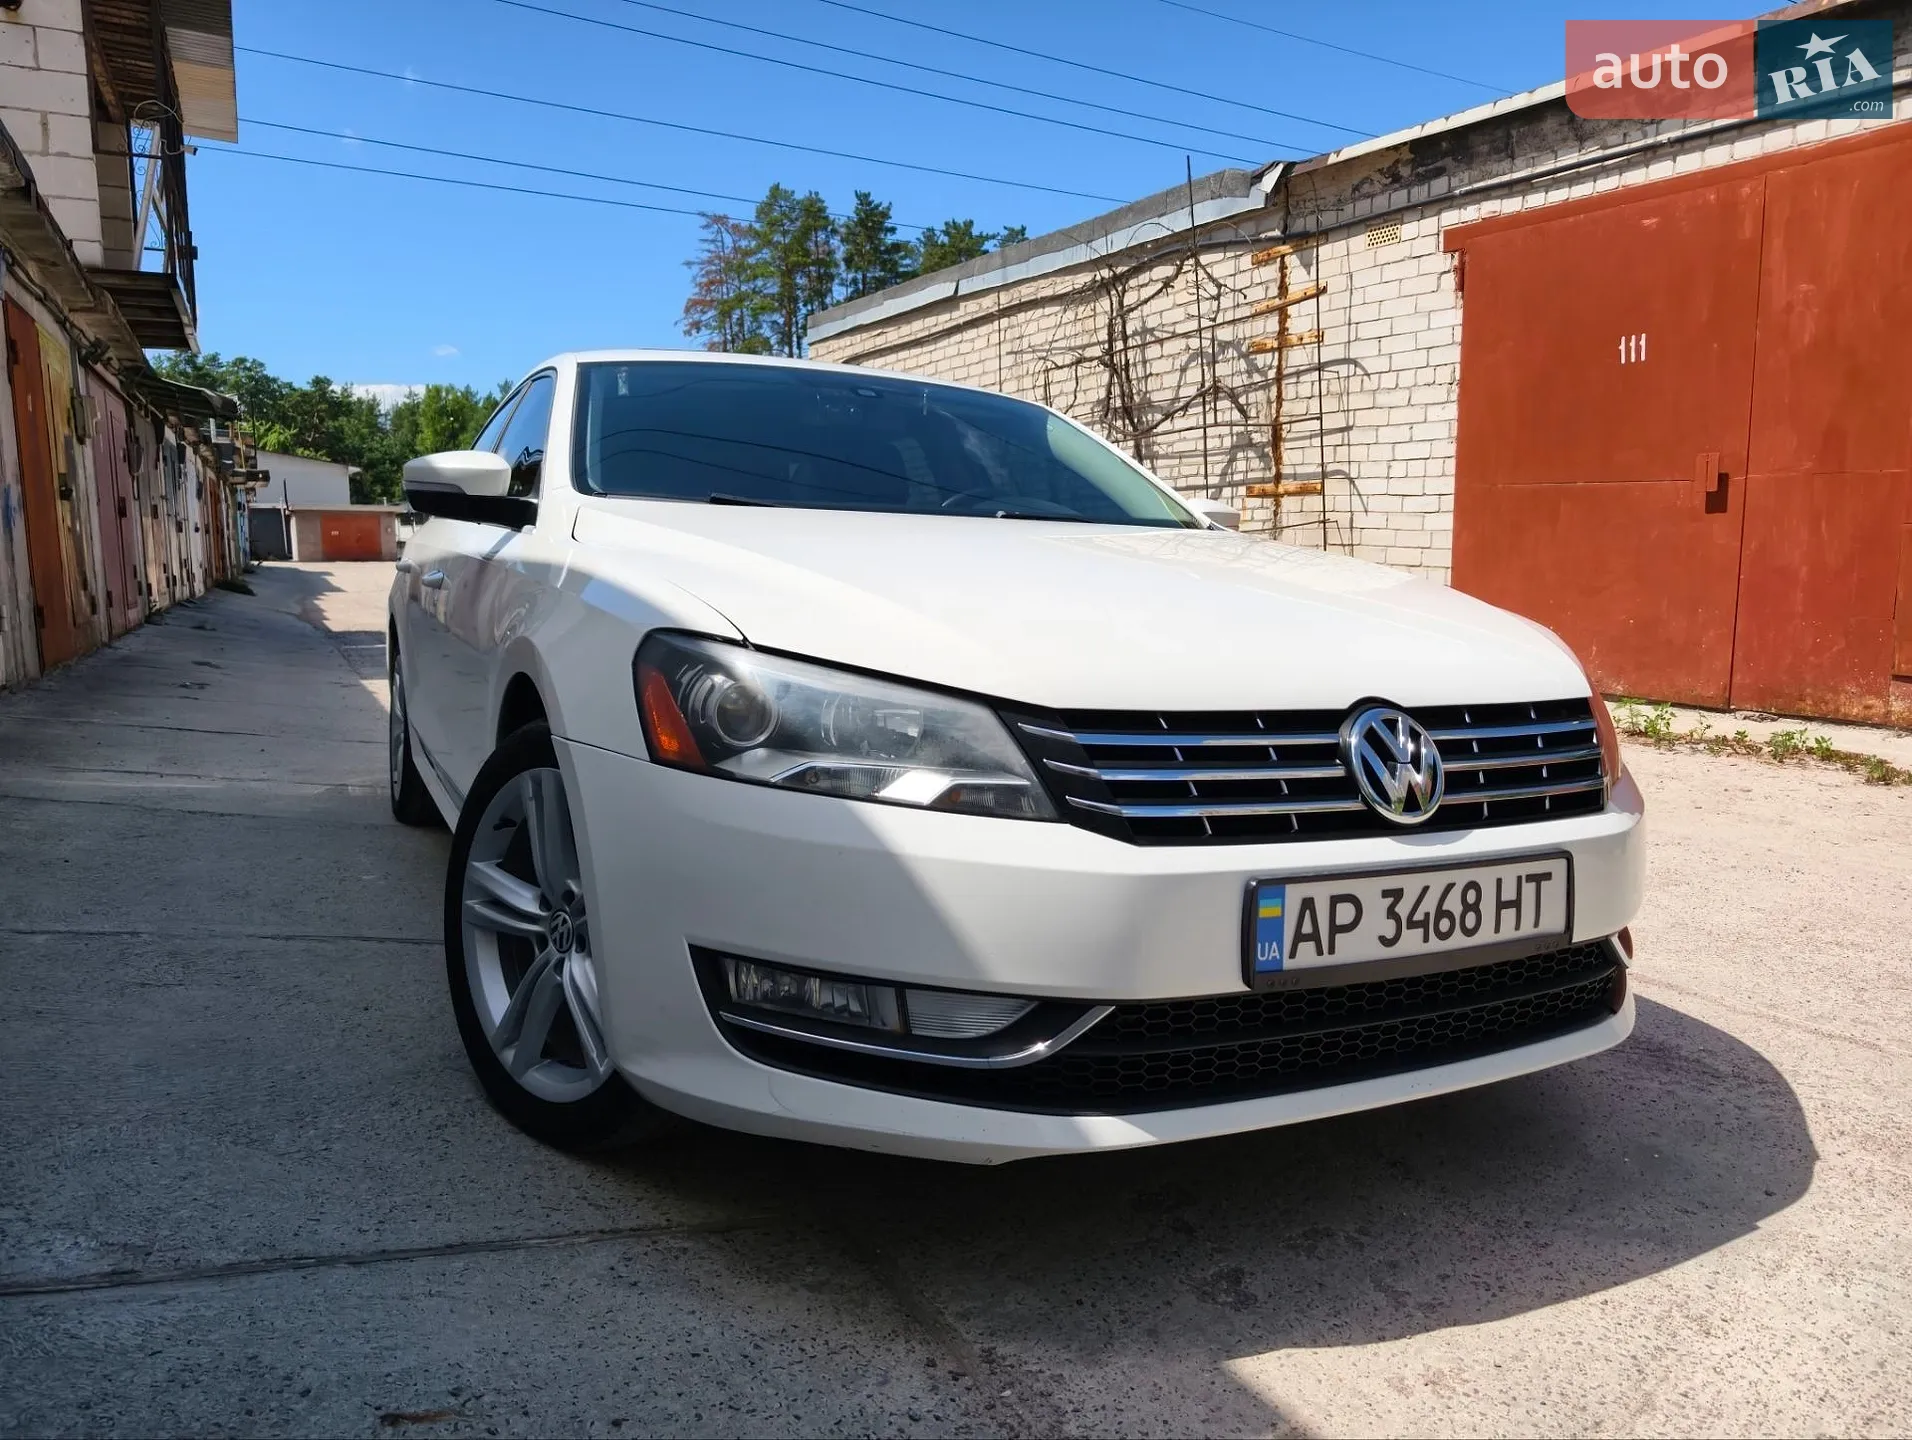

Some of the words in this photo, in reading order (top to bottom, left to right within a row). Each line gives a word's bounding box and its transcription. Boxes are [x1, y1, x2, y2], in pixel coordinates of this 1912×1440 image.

[1619, 333, 1646, 364] 111
[1355, 711, 1440, 819] VW
[1288, 893, 1364, 960] AP
[1377, 880, 1483, 948] 3468
[1493, 871, 1553, 935] HT
[1257, 943, 1281, 961] UA
